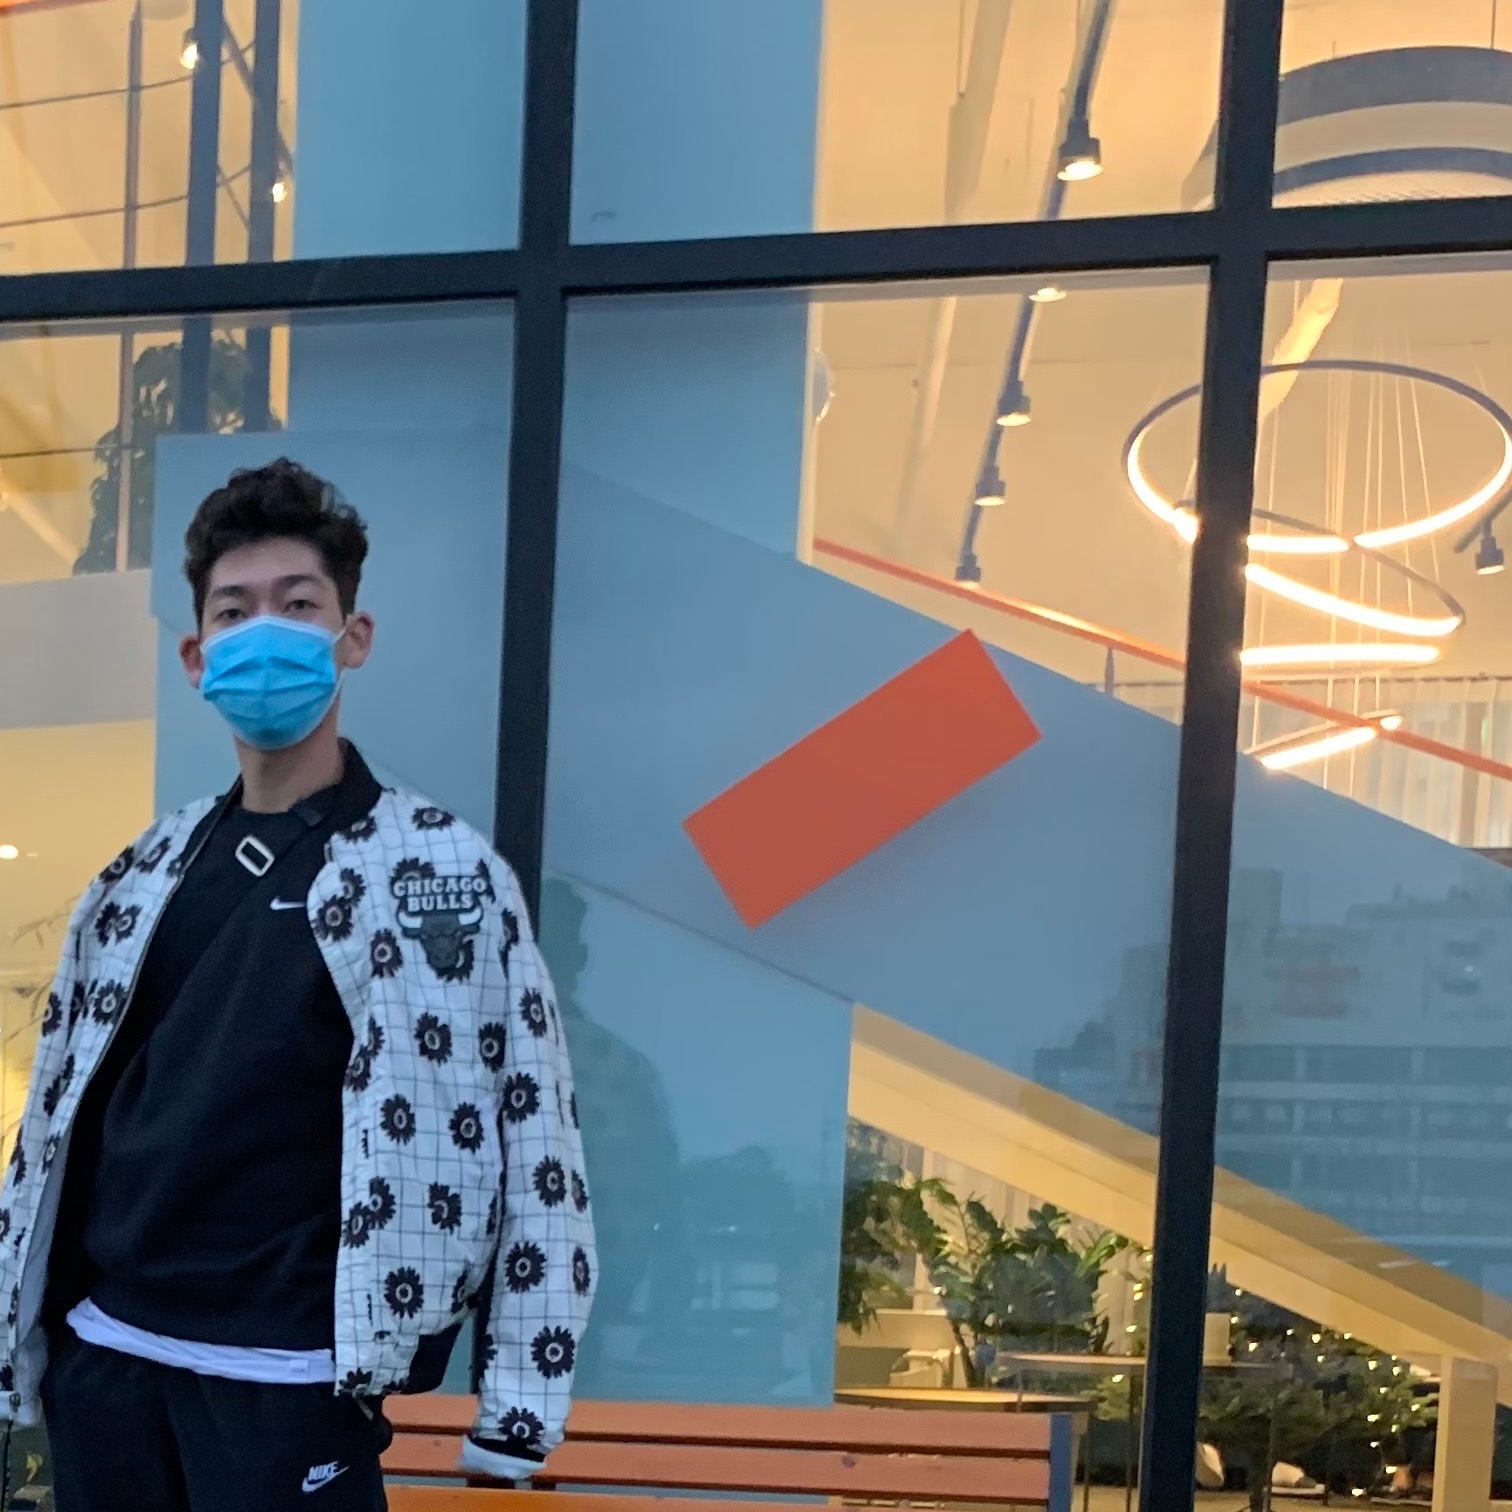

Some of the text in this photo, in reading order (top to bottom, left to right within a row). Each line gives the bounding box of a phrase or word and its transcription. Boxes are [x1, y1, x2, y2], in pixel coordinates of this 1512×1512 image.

[392, 876, 486, 897] CHICAGO
[406, 893, 473, 912] BULLS
[308, 1460, 339, 1481] NIKE
